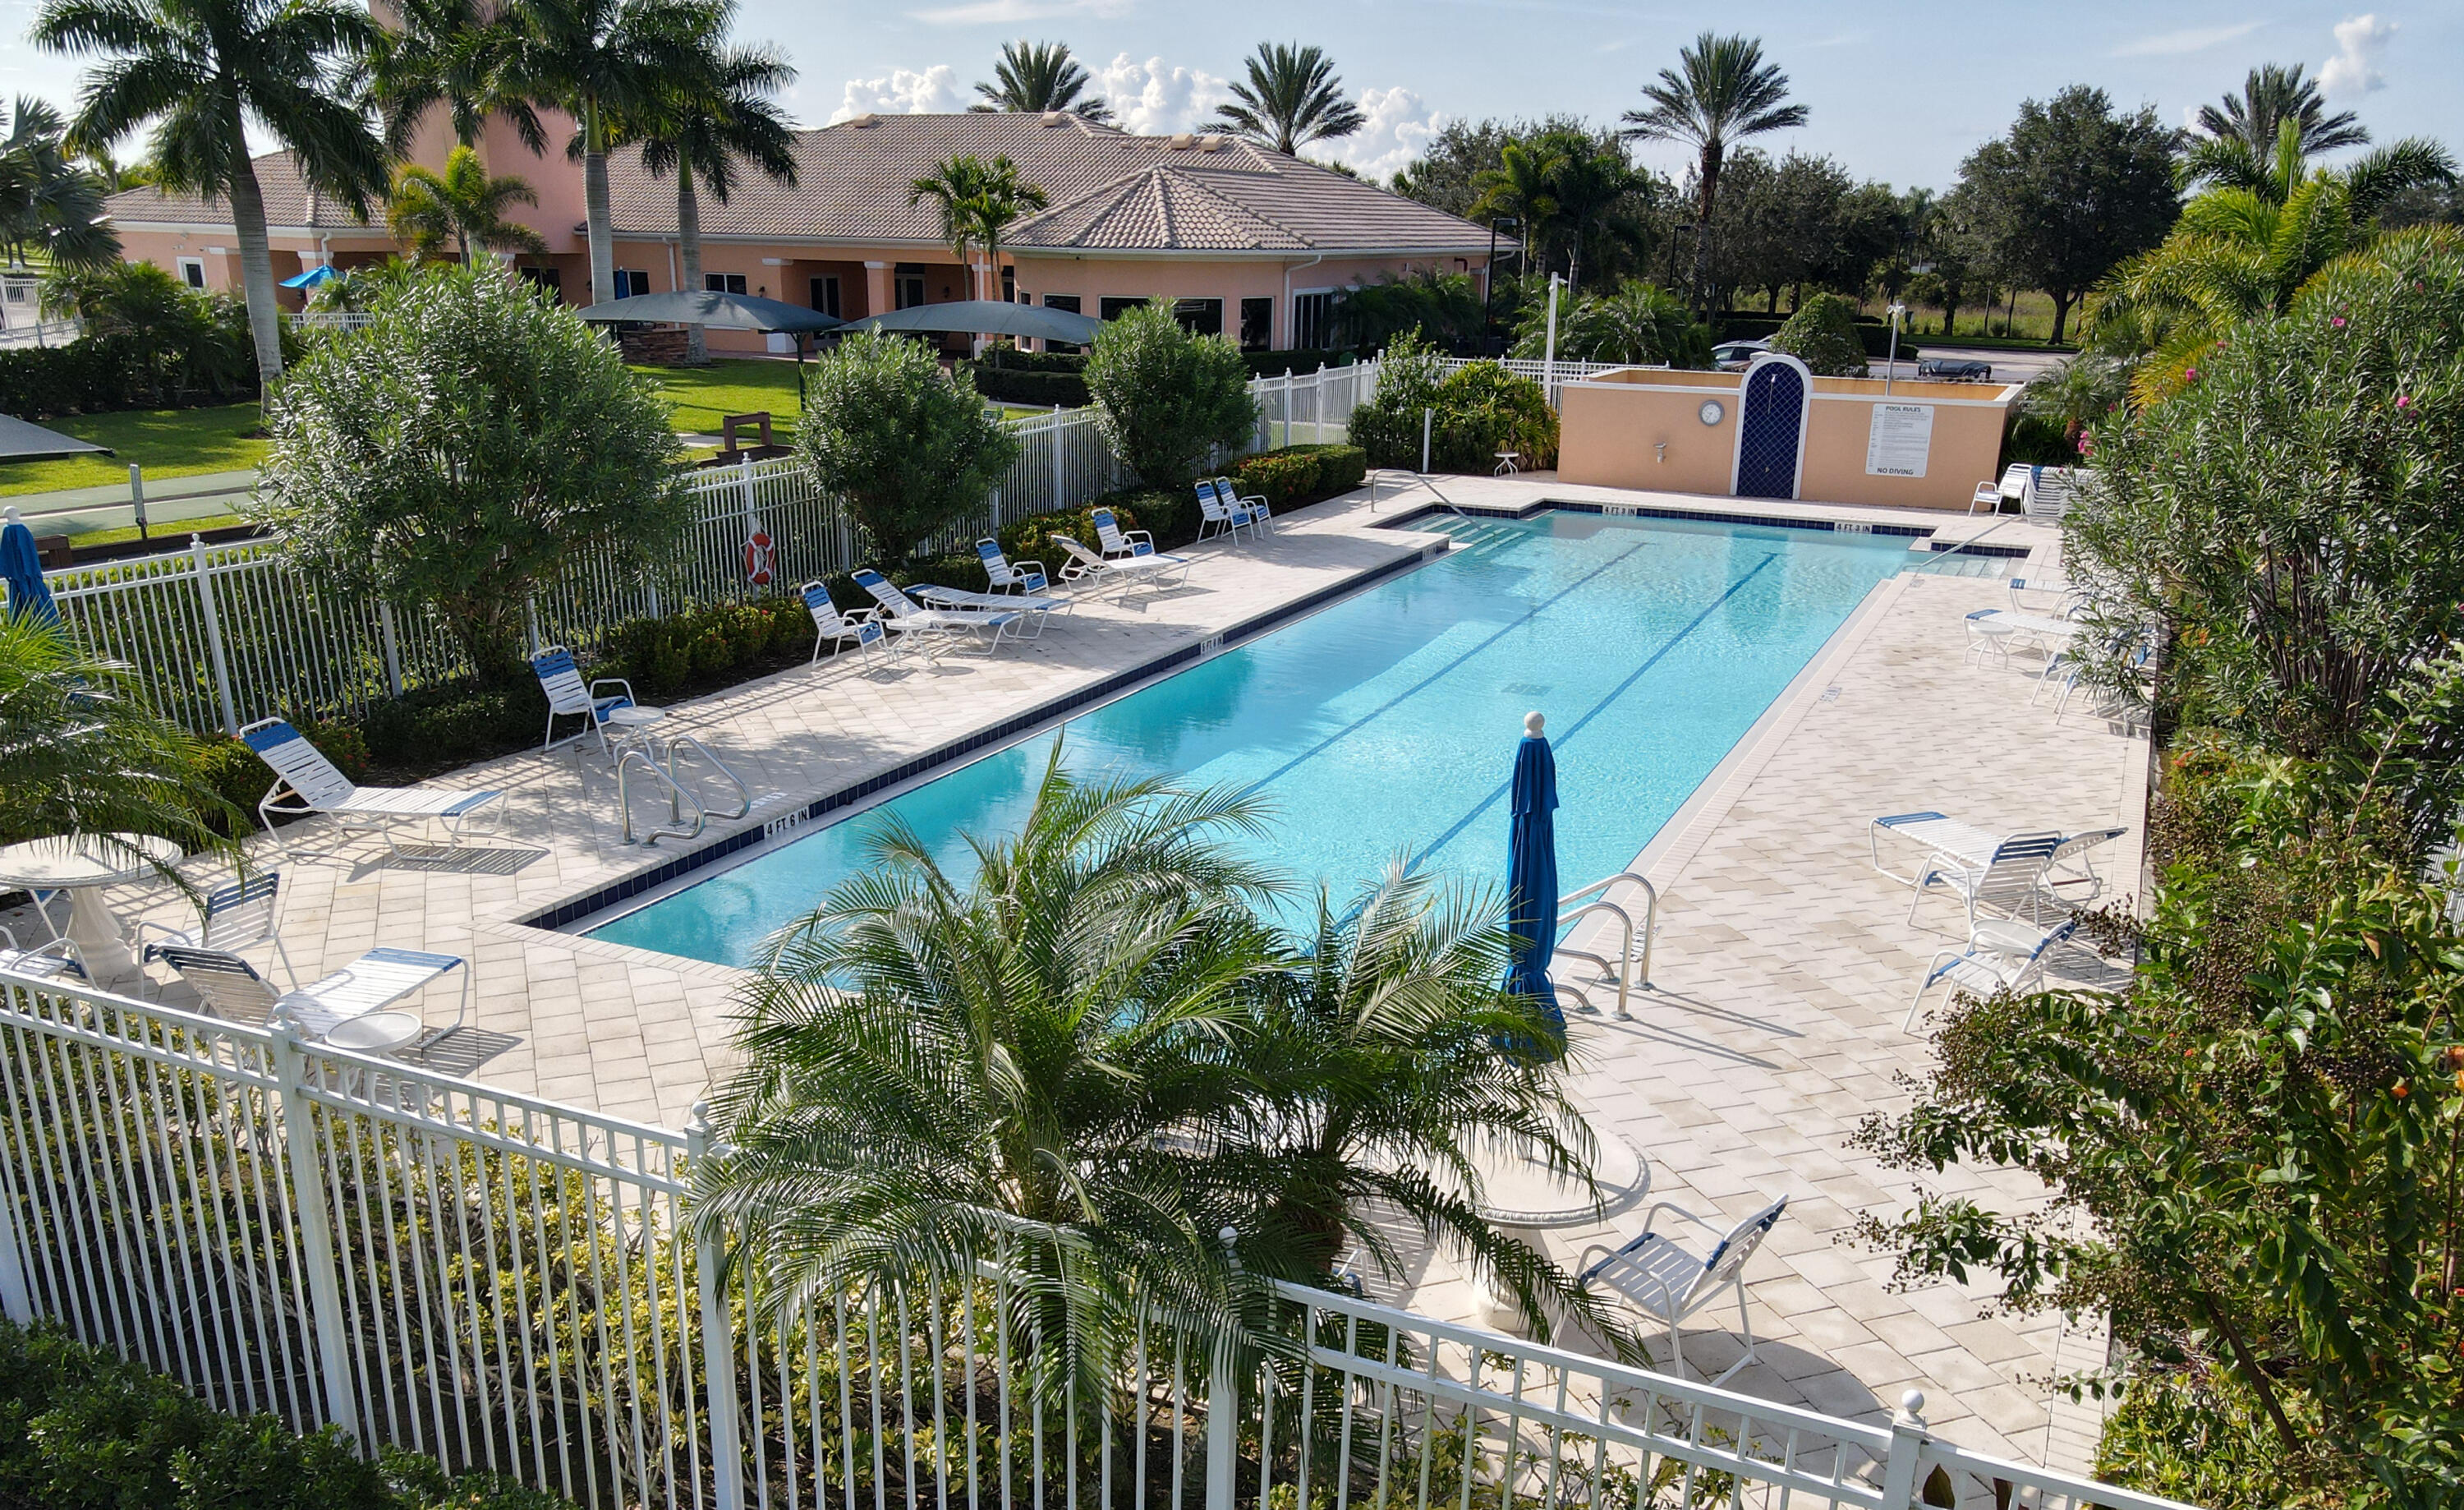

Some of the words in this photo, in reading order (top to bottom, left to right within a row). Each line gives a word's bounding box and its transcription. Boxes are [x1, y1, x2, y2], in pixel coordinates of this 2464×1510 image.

[1628, 508, 1635, 516] IN
[767, 823, 773, 836] 4
[775, 817, 786, 832] FT
[789, 814, 796, 826] 6
